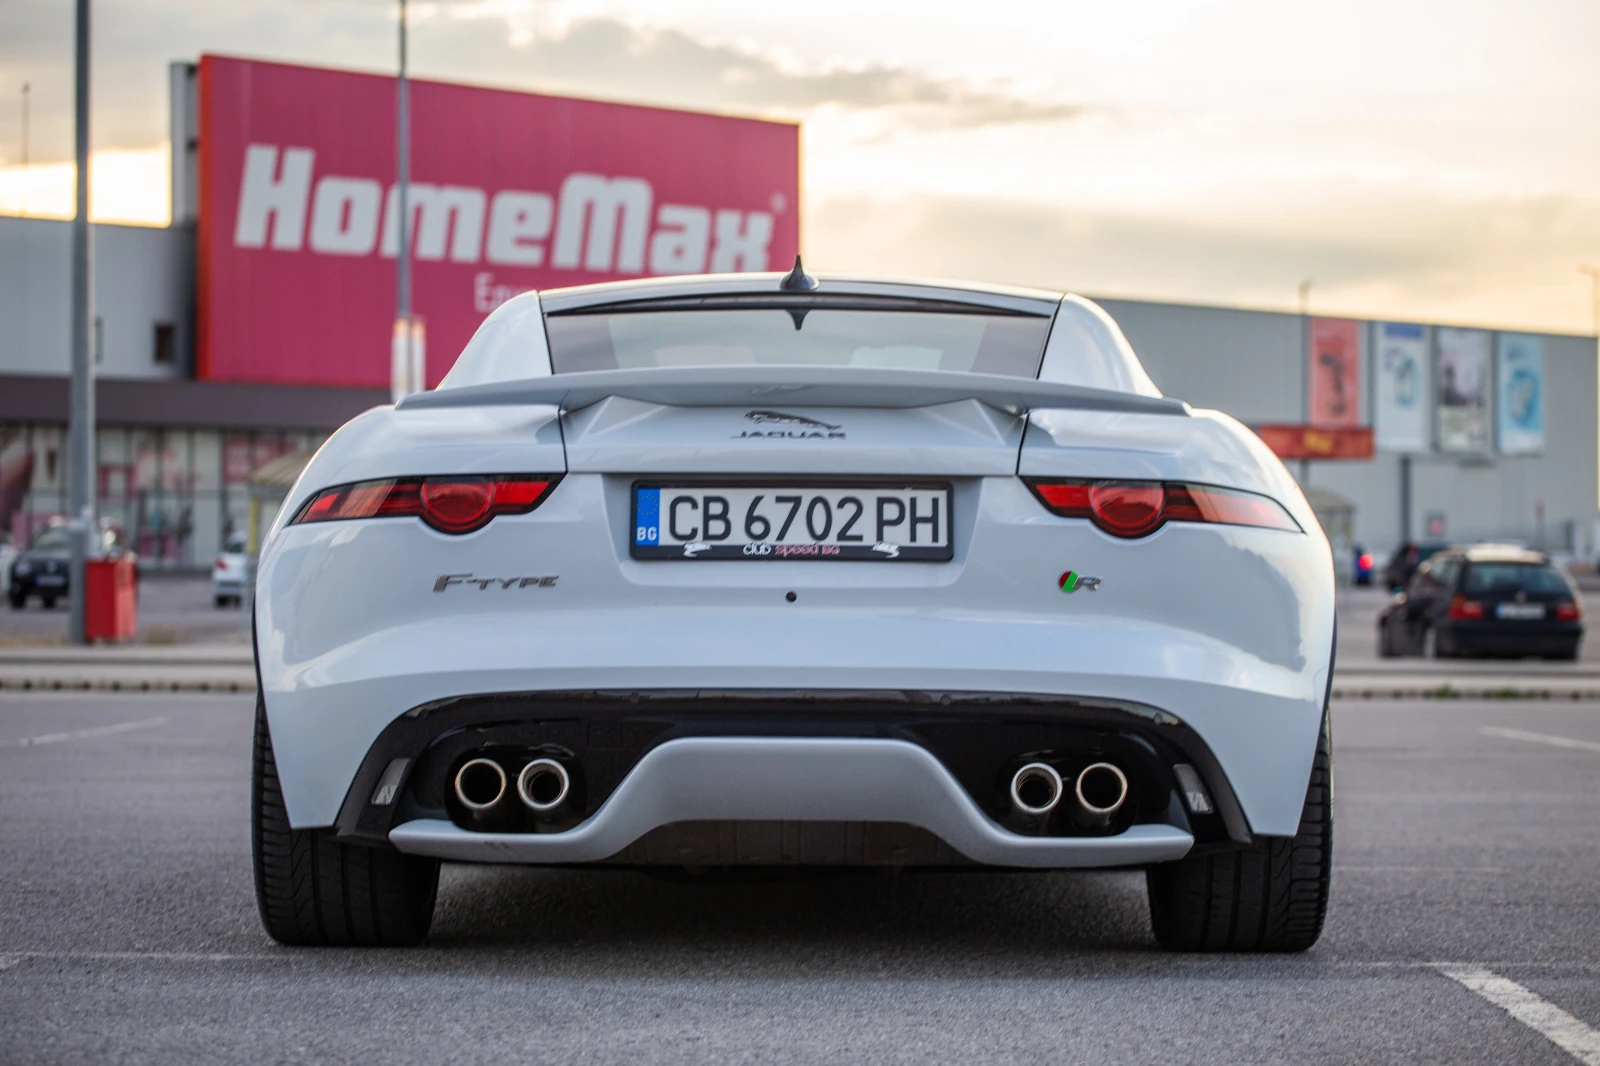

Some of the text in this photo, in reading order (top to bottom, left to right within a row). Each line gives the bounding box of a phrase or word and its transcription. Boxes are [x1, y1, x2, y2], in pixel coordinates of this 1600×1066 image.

[234, 143, 775, 274] HomeMax
[730, 430, 846, 440] JAGUAR
[743, 495, 864, 542] 6702
[875, 496, 940, 544] PH
[636, 526, 658, 542] BG
[433, 573, 559, 593] F-TYPE
